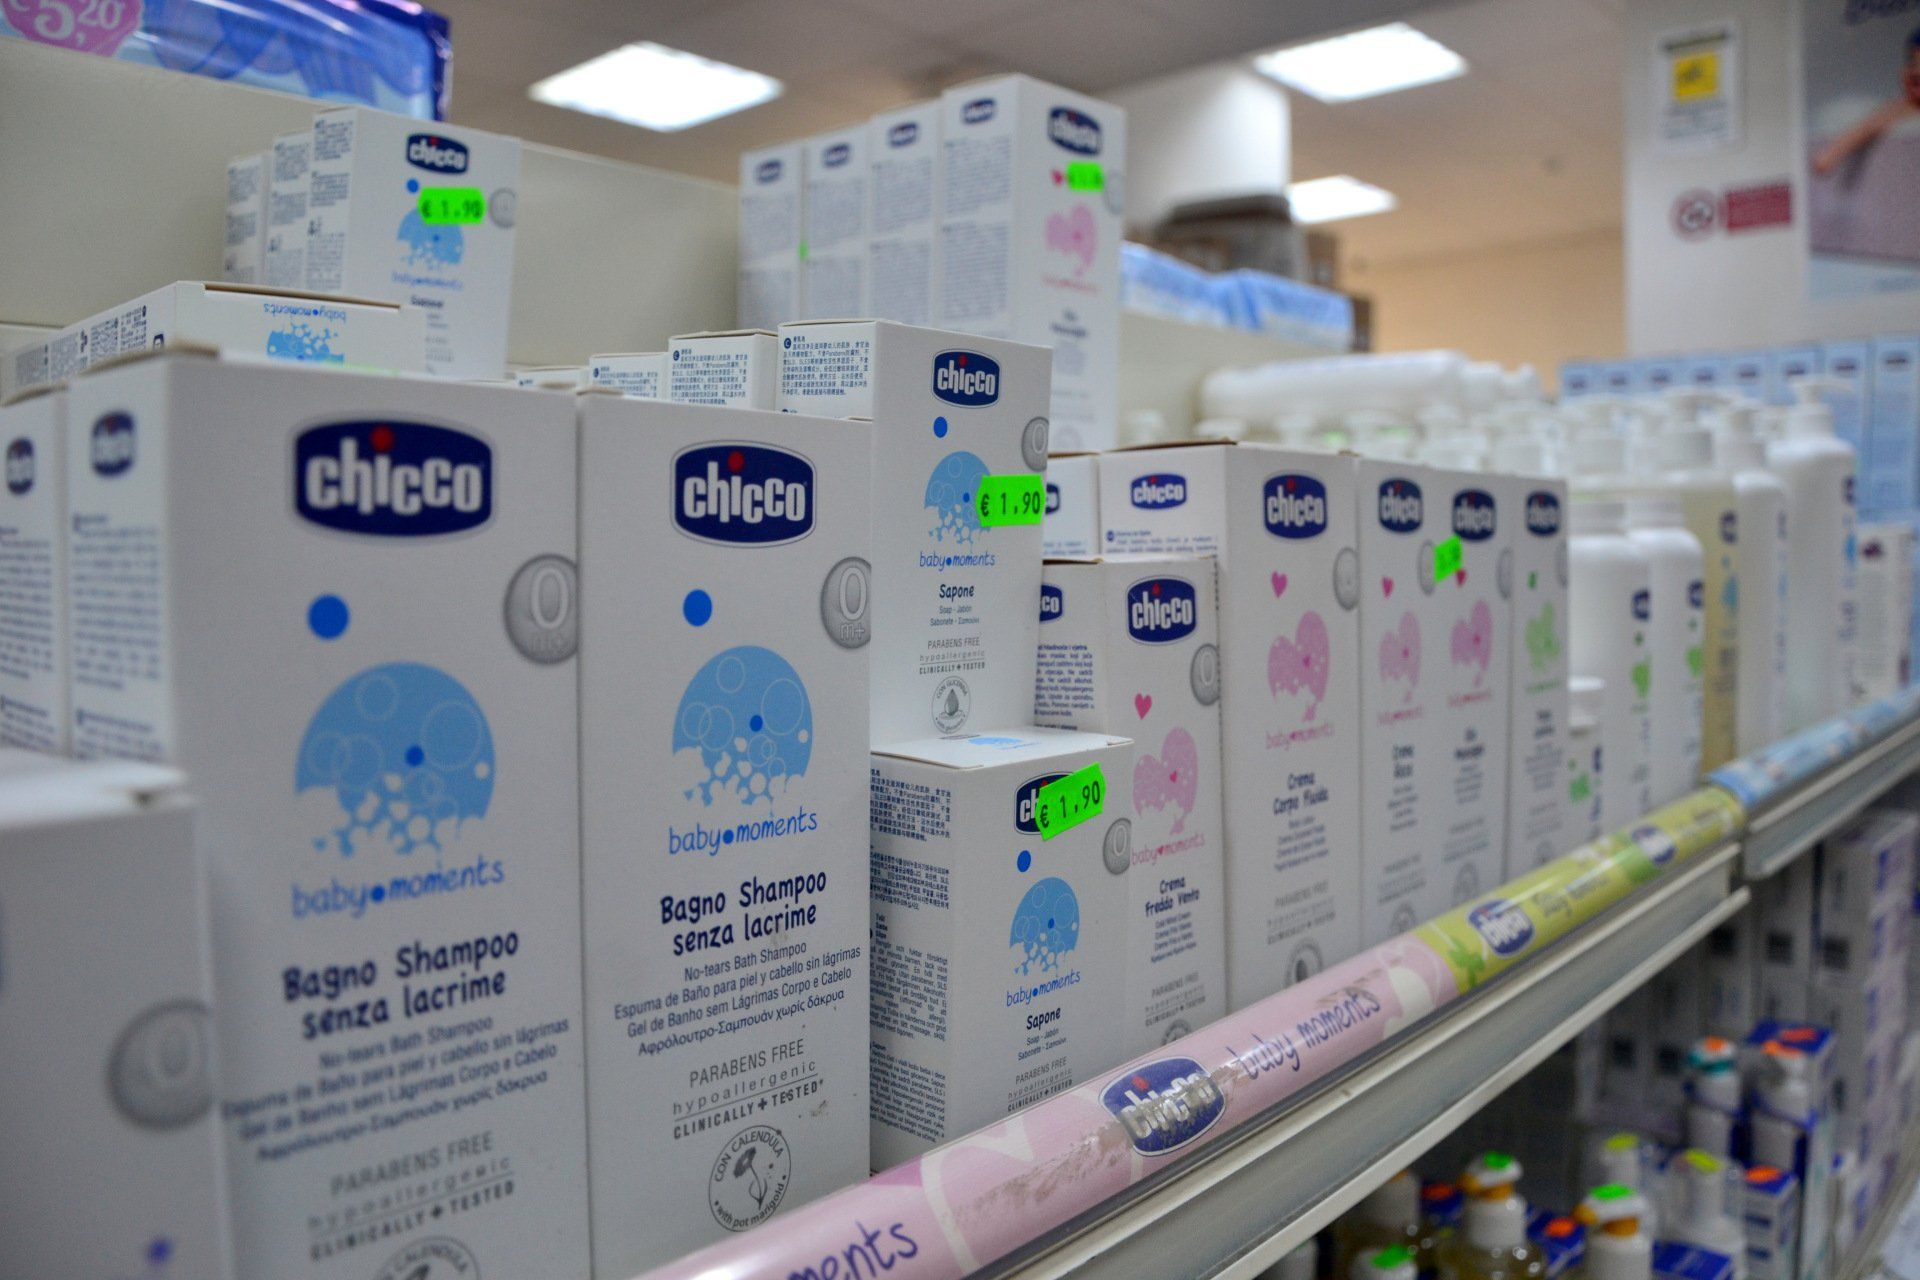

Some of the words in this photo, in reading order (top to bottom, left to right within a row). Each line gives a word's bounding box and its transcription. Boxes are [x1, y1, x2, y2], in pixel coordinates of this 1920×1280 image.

[937, 355, 996, 397] chicco
[304, 424, 483, 516] chicco
[683, 450, 806, 524] chicco
[1134, 475, 1184, 503] chicco
[980, 493, 990, 517] €
[1000, 491, 1041, 516] 1,90
[1266, 482, 1324, 528] chicco
[919, 551, 946, 572] baby
[952, 549, 996, 567] moments
[839, 567, 868, 621] 0
[939, 584, 975, 602] Sapone
[1132, 580, 1192, 631] chicco
[927, 638, 963, 650] PARABENS
[964, 636, 980, 646] FREE
[1040, 804, 1050, 829] €
[1059, 780, 1101, 819] 1,90
[669, 824, 720, 857] baby
[735, 805, 819, 844] moments
[1131, 846, 1158, 867] baby
[291, 877, 367, 920] baby
[387, 855, 506, 899] moments
[661, 890, 726, 926] Bagno
[738, 871, 828, 912] Shampoo
[1159, 876, 1186, 895] Crema
[672, 923, 735, 957] senza
[743, 903, 818, 942] lacrime
[281, 958, 377, 1005] Bagno
[395, 930, 520, 981] Shampoo
[614, 998, 662, 1021] Espuma
[665, 992, 680, 1008] de
[682, 982, 711, 1004] Baño
[713, 978, 737, 999] para
[739, 969, 759, 990] piel
[769, 960, 804, 985] cabello
[806, 955, 821, 972] sin
[822, 945, 861, 970] lágrimas
[684, 959, 732, 983] No-tears
[734, 953, 758, 972] Bath
[760, 941, 808, 967] Shampoo
[301, 999, 390, 1040] senza
[404, 970, 507, 1020] lacrime
[627, 1020, 648, 1040] Gel
[650, 1016, 665, 1033] de
[667, 1007, 703, 1029] Banho
[705, 1001, 730, 1018] sem
[731, 985, 780, 1015] Lágrimas
[781, 978, 812, 1000] Corpo
[821, 965, 852, 986] Cabelo
[807, 988, 846, 1011] δάκρυα
[1006, 985, 1034, 1008] baby
[1038, 969, 1082, 995] moments
[427, 1017, 493, 1044] Shampoo
[492, 1033, 513, 1051] sin
[515, 1018, 570, 1045] lágrimas
[1026, 1007, 1061, 1031] Sapone
[1226, 1033, 1300, 1080] baby
[1297, 993, 1381, 1049] moments
[458, 1061, 501, 1084] Corpo
[513, 1041, 559, 1068] Cabelo
[689, 1050, 768, 1089] PARABENS
[771, 1038, 805, 1064] FREE
[1015, 1063, 1050, 1086] PARABENS
[1051, 1056, 1068, 1072] FREE
[672, 1058, 817, 1117] hypoallergenic
[673, 1101, 755, 1140] CLINICALLY
[330, 1148, 442, 1195] PARABENS
[446, 1131, 494, 1161] FREE
[714, 1152, 732, 1183] CON
[731, 1130, 784, 1159] CALENDULA
[450, 1180, 515, 1215] TESTED
[716, 1205, 734, 1225] with
[732, 1217, 749, 1230] pot
[750, 1182, 786, 1225] marigold
